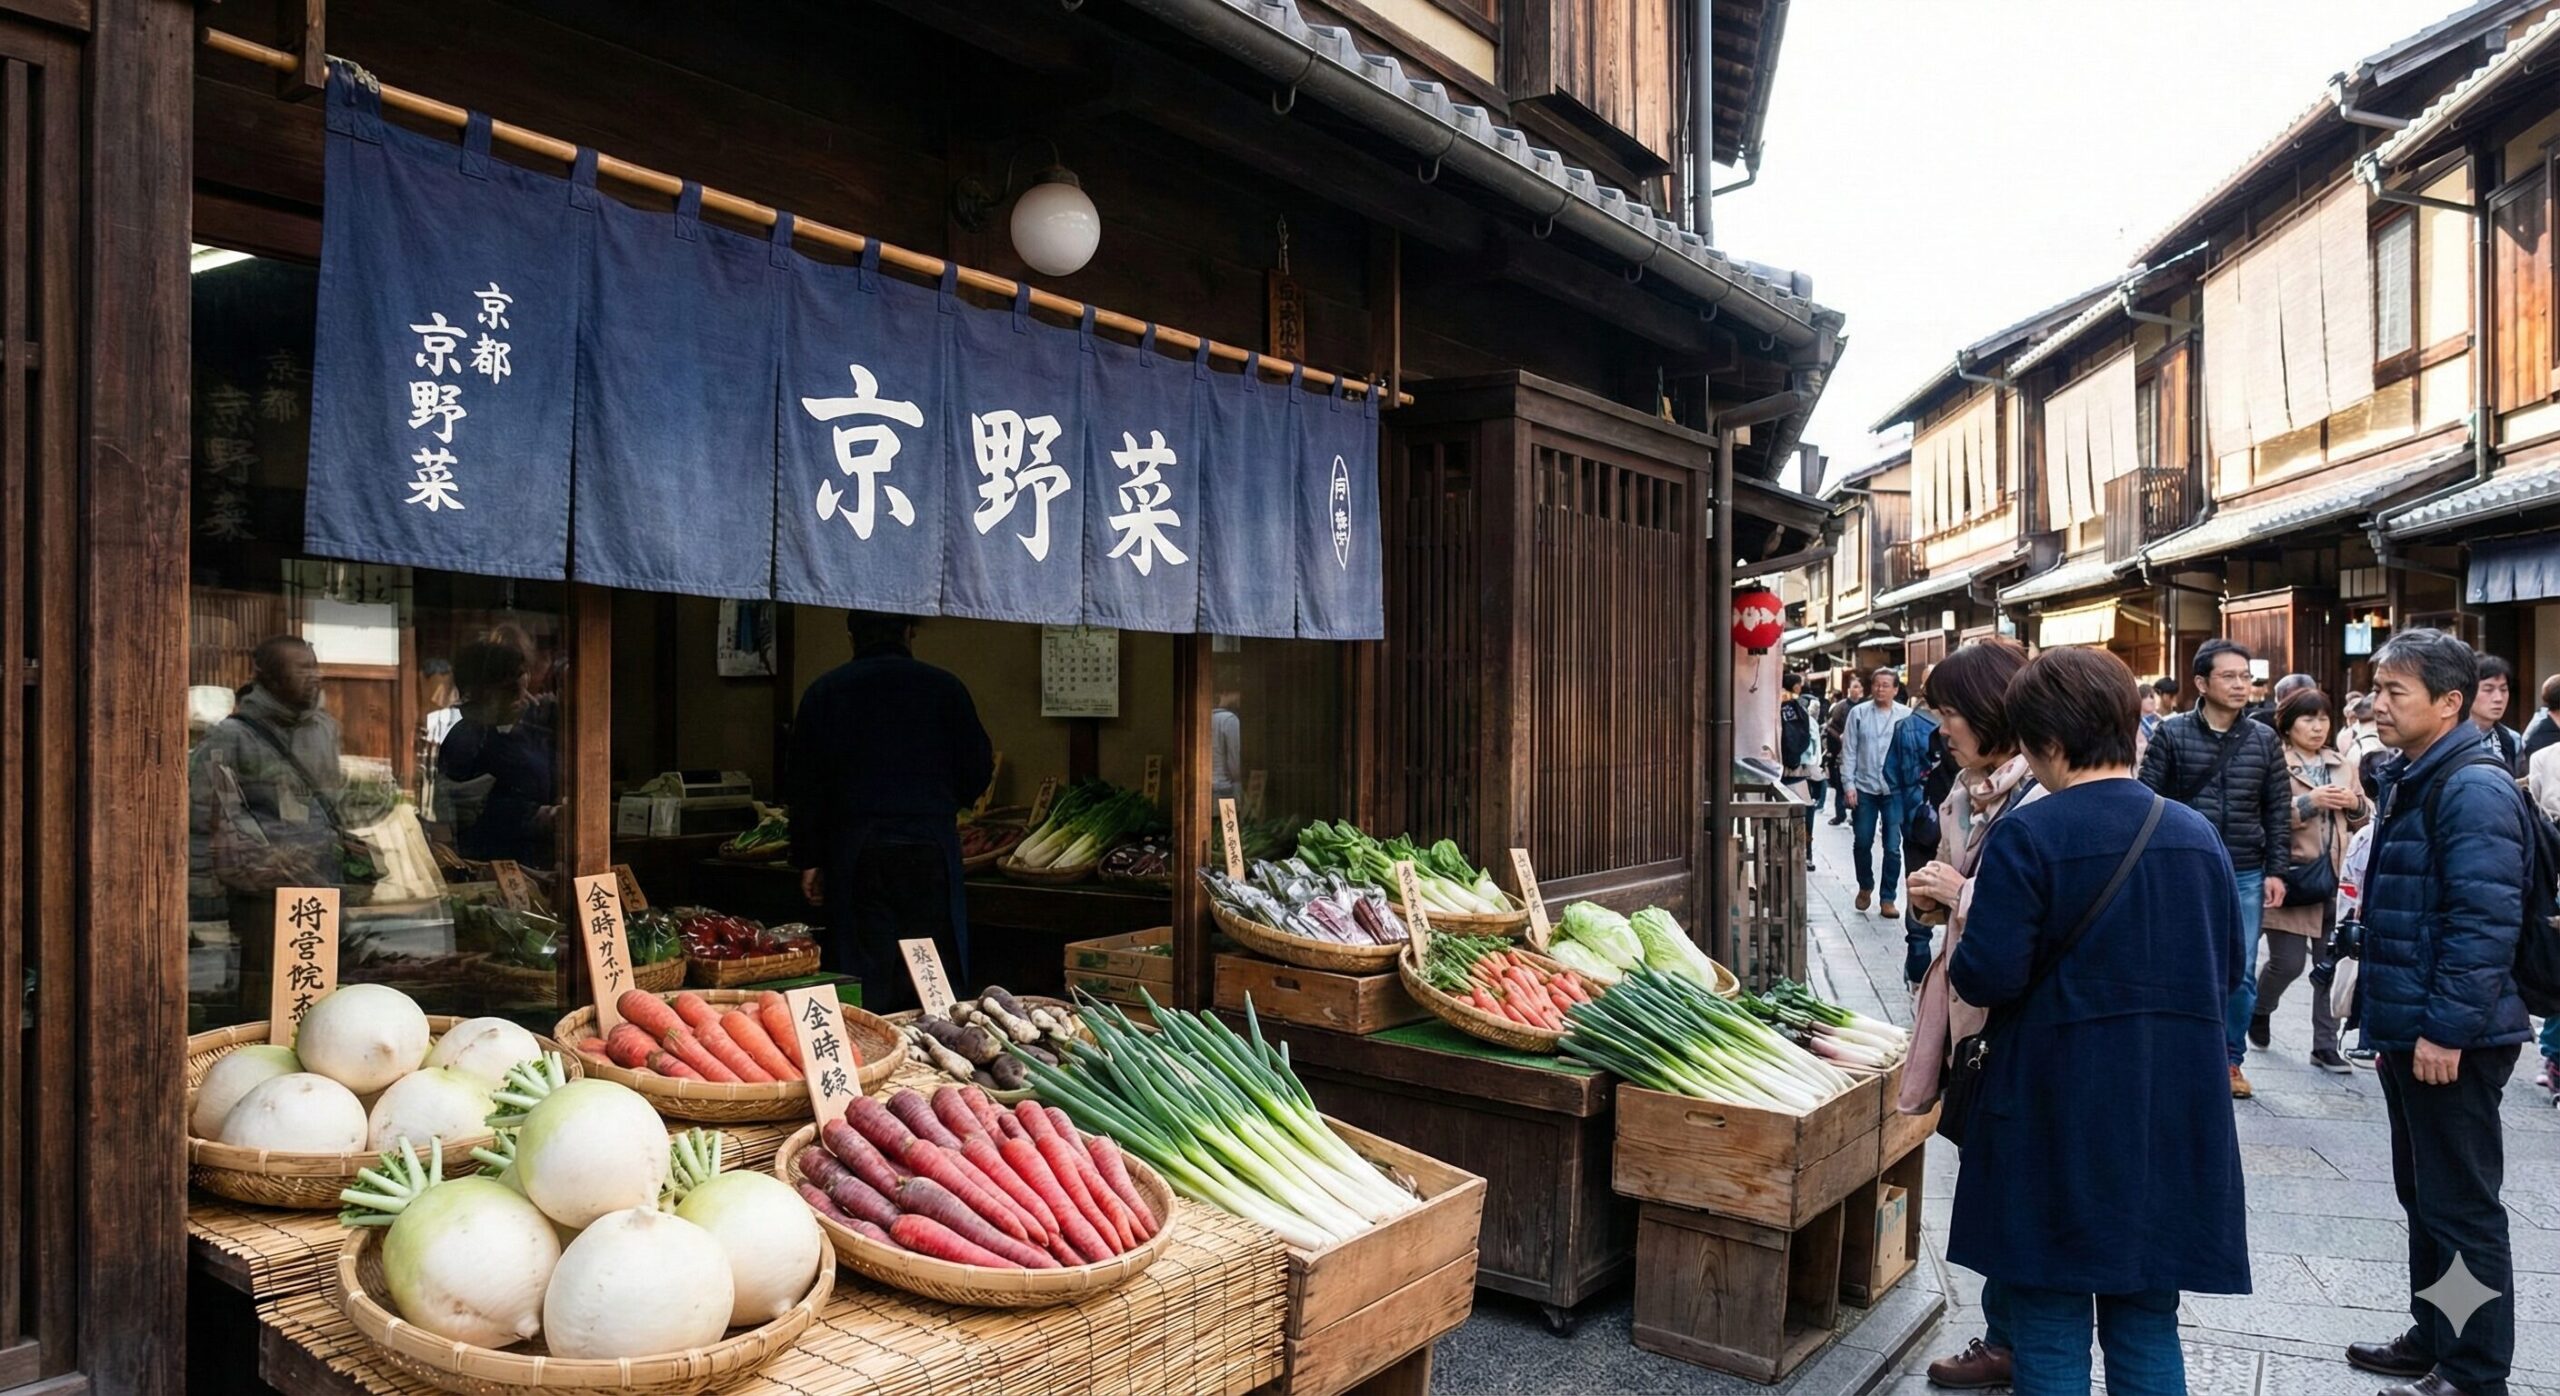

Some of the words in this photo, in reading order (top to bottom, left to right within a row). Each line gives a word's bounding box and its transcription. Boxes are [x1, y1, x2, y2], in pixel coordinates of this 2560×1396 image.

[404, 312, 468, 513] 京野菜
[470, 281, 514, 384] 京都
[801, 363, 1190, 577] 京野菜
